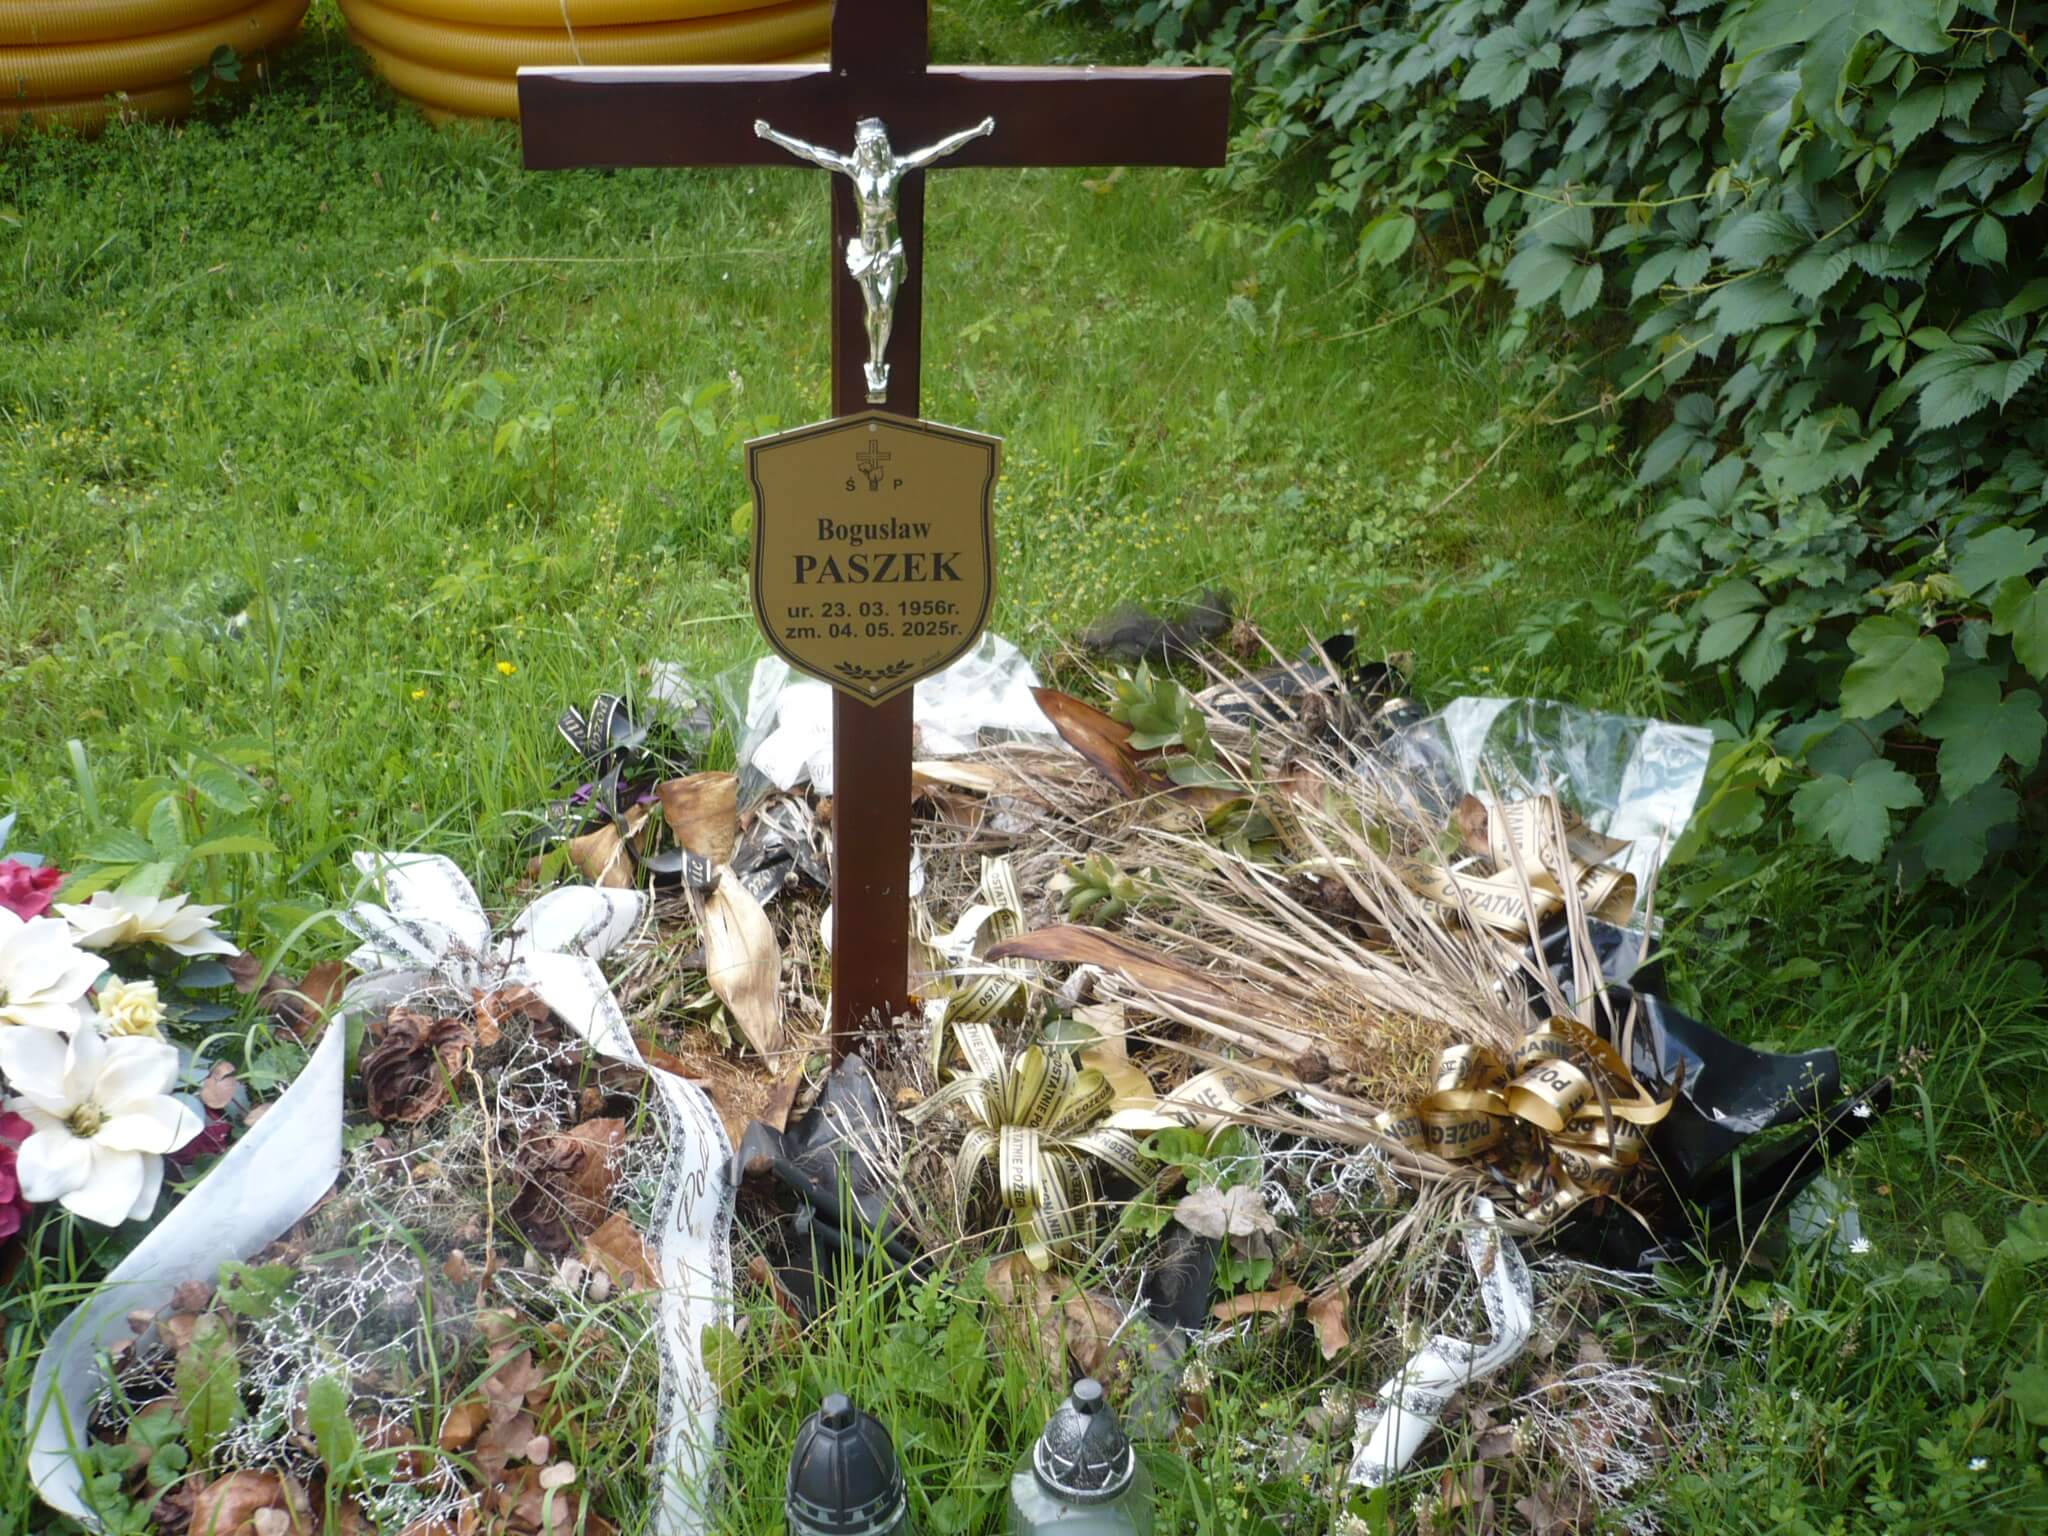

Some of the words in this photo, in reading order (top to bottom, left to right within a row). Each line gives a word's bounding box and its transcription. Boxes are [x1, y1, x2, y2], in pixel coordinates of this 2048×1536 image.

[846, 476, 856, 492] Ś
[893, 479, 903, 491] P
[817, 517, 931, 547] Bogusław
[792, 552, 963, 585] PASZEK
[787, 605, 814, 618] ur.
[821, 603, 851, 618] 23.
[859, 603, 889, 617] 03.
[898, 600, 960, 616] 1956r.
[785, 626, 821, 640] zm.
[828, 624, 858, 638] 04.
[865, 623, 895, 638] 05.
[902, 621, 963, 637] 2025r.
